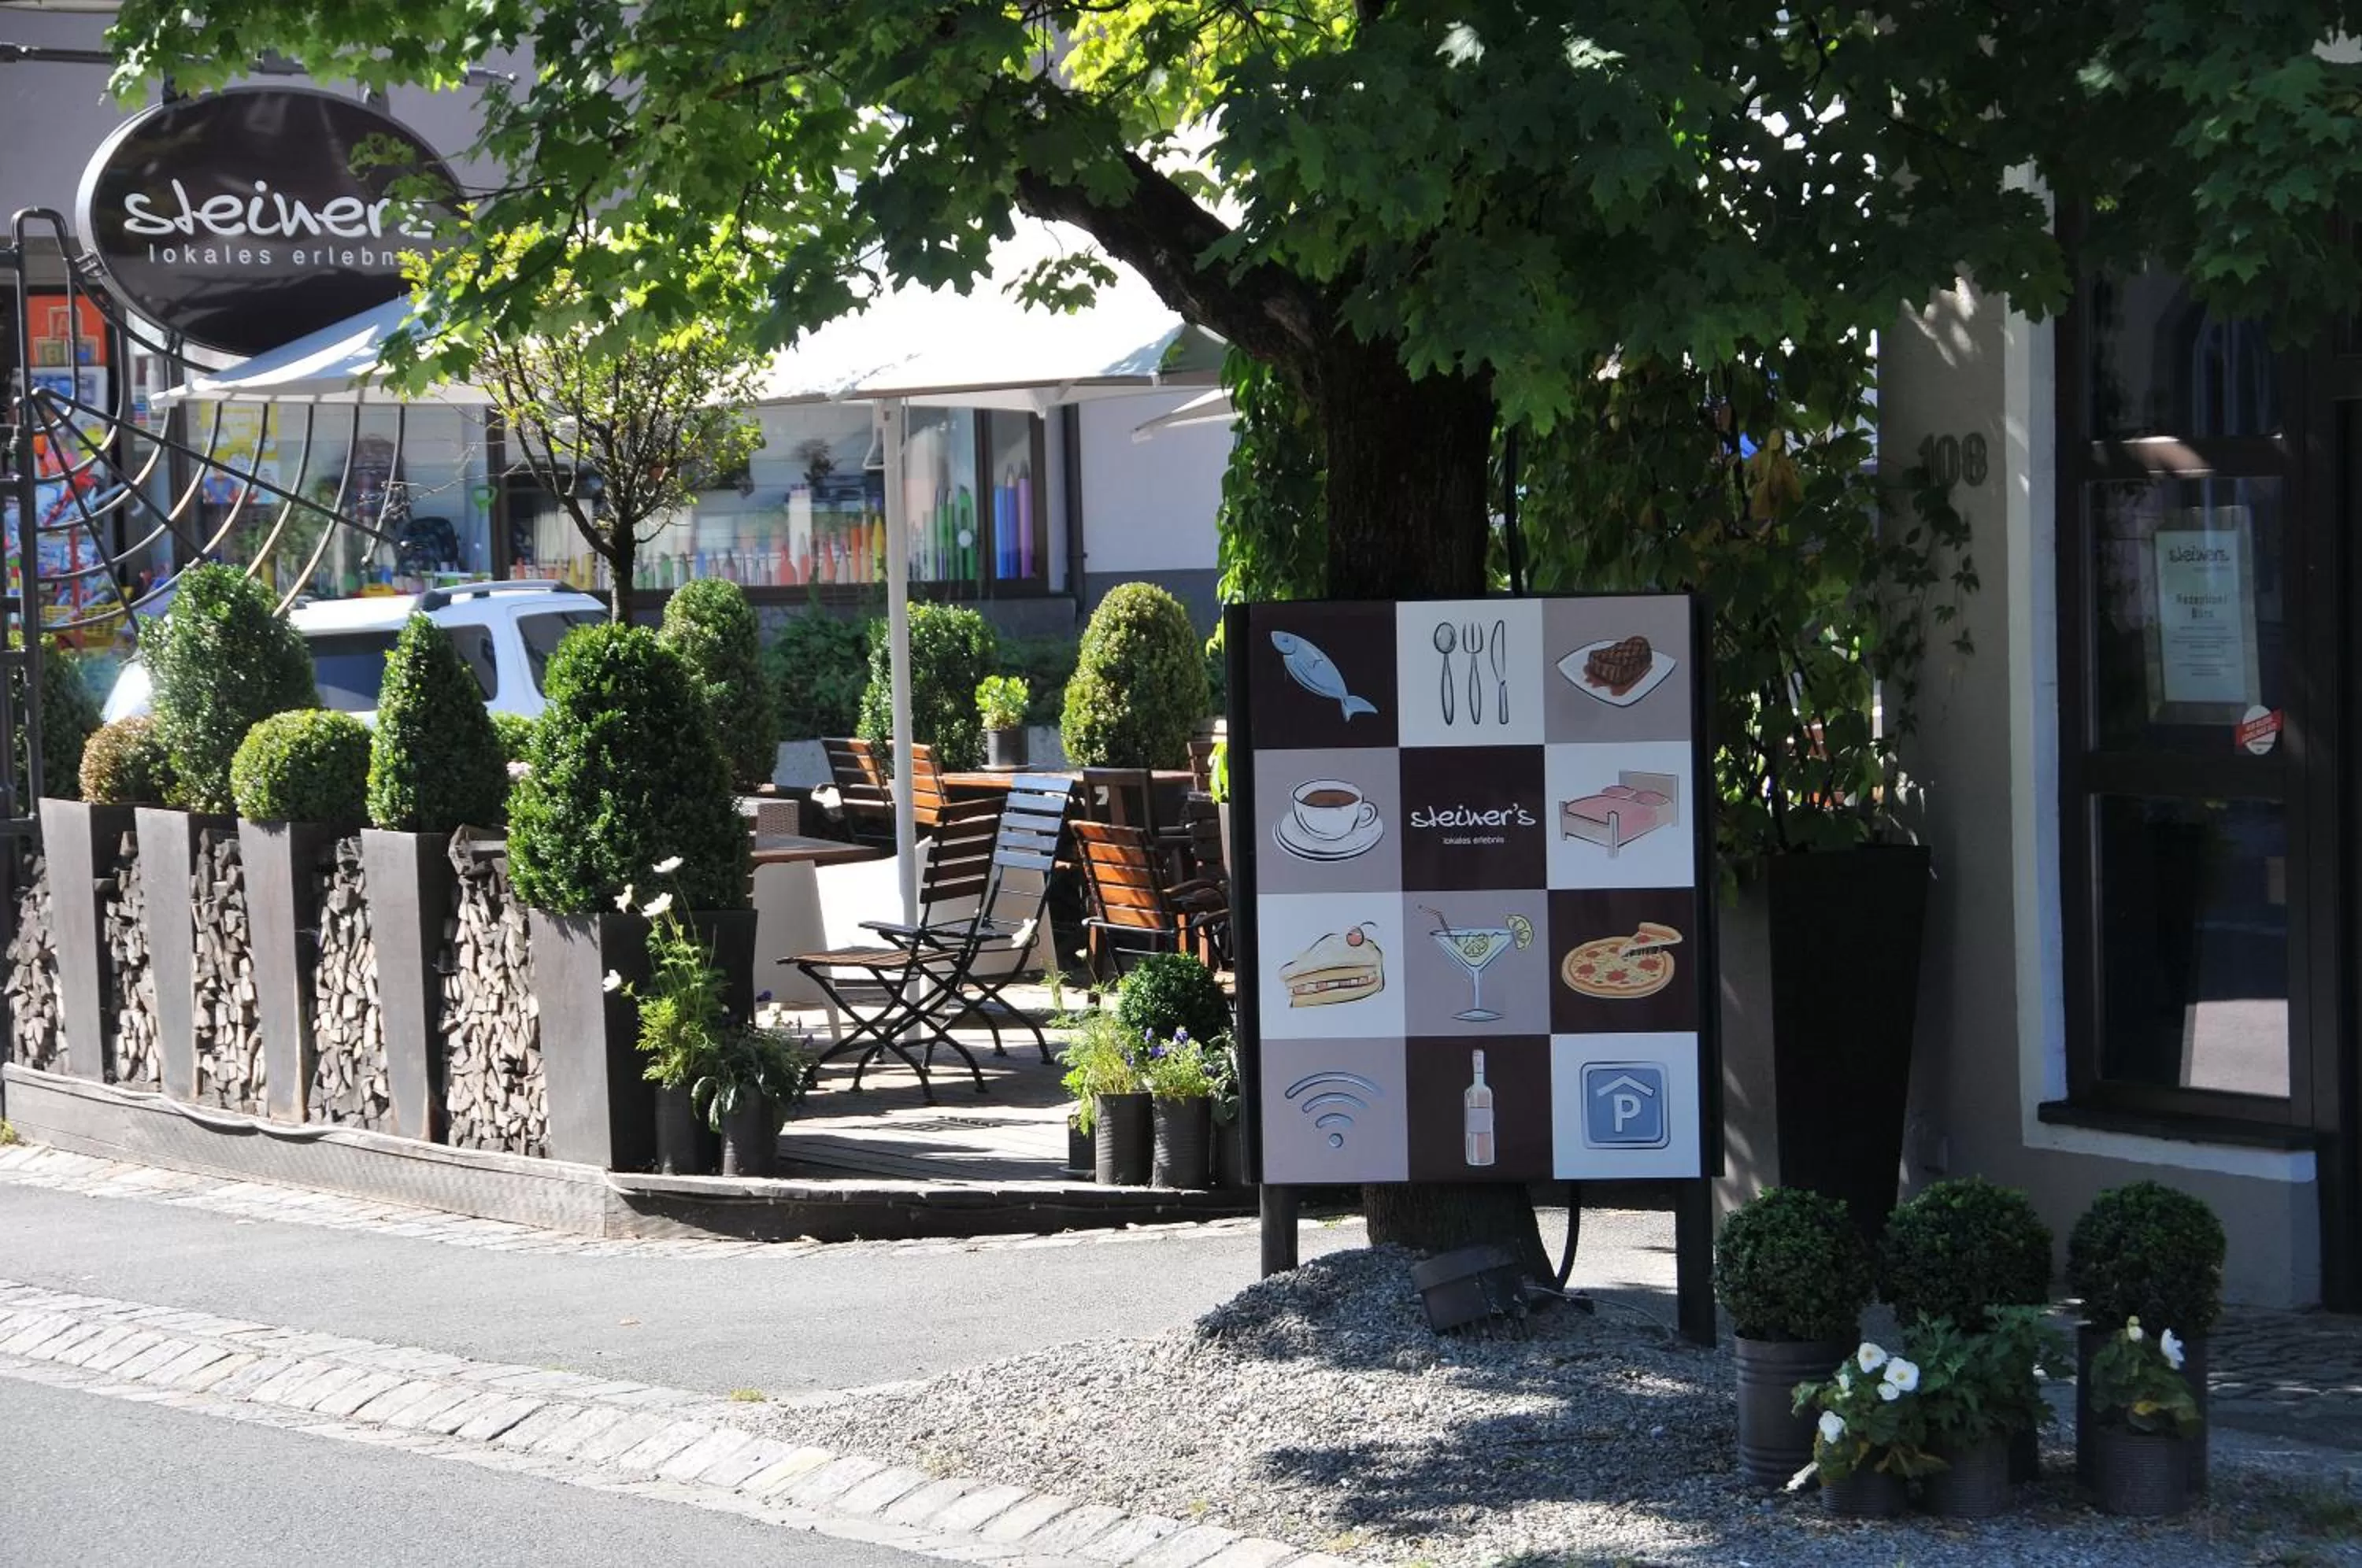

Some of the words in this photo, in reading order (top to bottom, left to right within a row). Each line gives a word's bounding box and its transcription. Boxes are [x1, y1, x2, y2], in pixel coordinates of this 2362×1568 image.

[149, 244, 272, 264] lokales
[293, 246, 426, 265] erlebn
[1917, 431, 1988, 489] 108
[1410, 803, 1536, 827] steiner's
[1442, 836, 1472, 845] lokales
[1613, 1093, 1642, 1133] P
